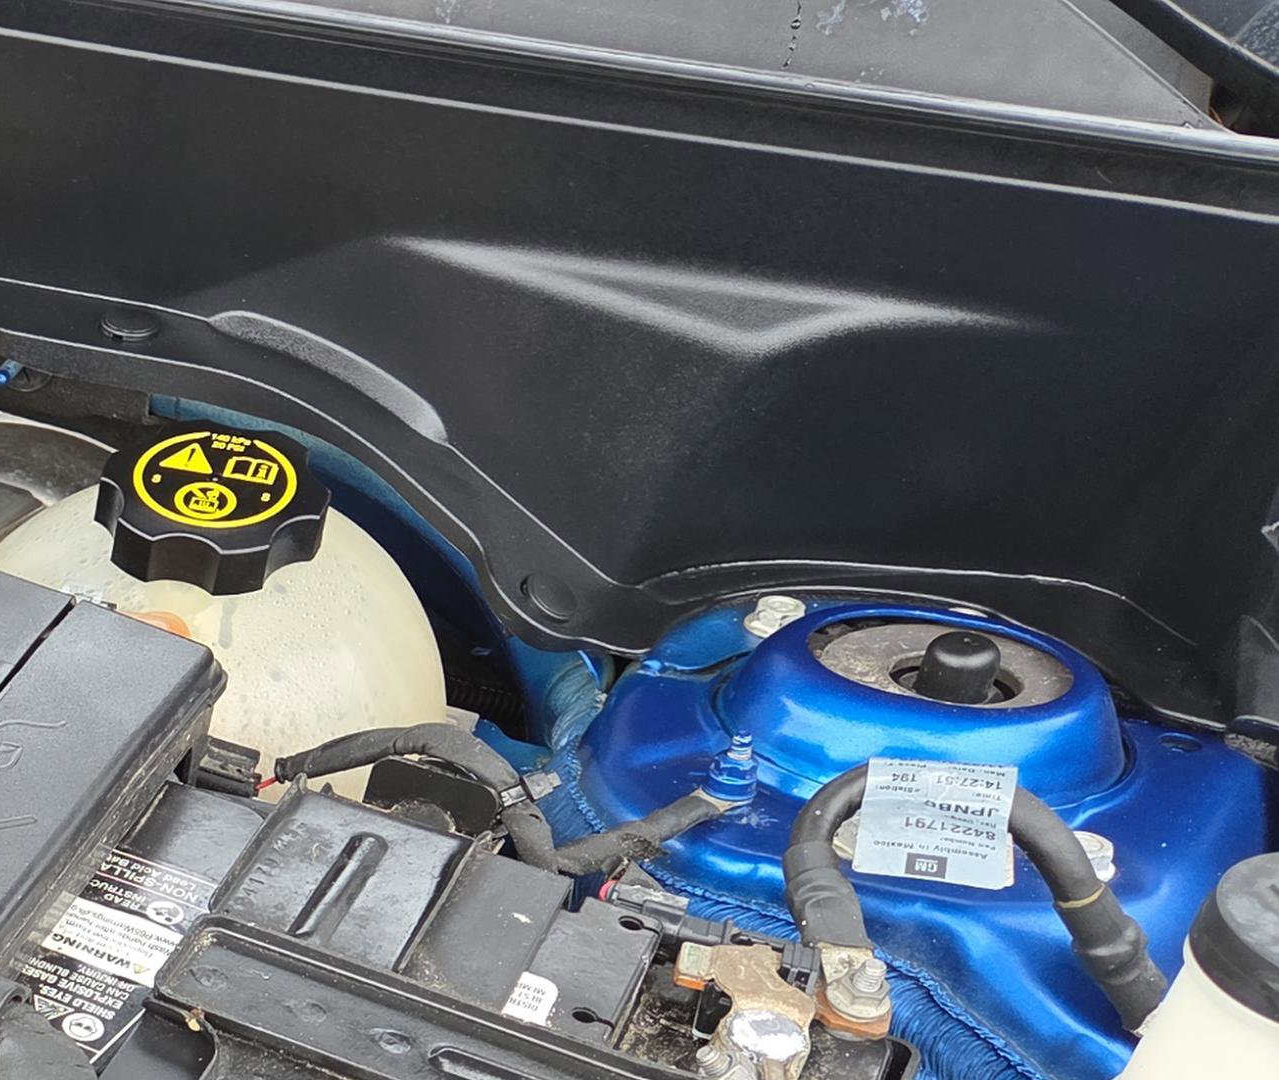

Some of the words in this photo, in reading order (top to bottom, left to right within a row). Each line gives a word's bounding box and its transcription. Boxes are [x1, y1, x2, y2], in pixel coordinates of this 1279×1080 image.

[892, 772, 916, 782] 194
[937, 775, 1003, 790] 14:27:51
[905, 817, 996, 840] 84221791
[873, 840, 913, 849] Mexico
[933, 845, 987, 859] Assembly
[128, 861, 162, 877] Acid
[915, 859, 938, 873] GM
[100, 860, 199, 902] NON-SPILLA
[103, 891, 140, 910] READ
[68, 971, 106, 991] CAUSE
[78, 963, 118, 985] INJURY.
[38, 982, 72, 1003] EYES.
[56, 977, 123, 1009] EXPLOSIVE
[105, 985, 129, 1000] CAN
[118, 980, 135, 992] OR
[71, 997, 115, 1020] SHIELD
